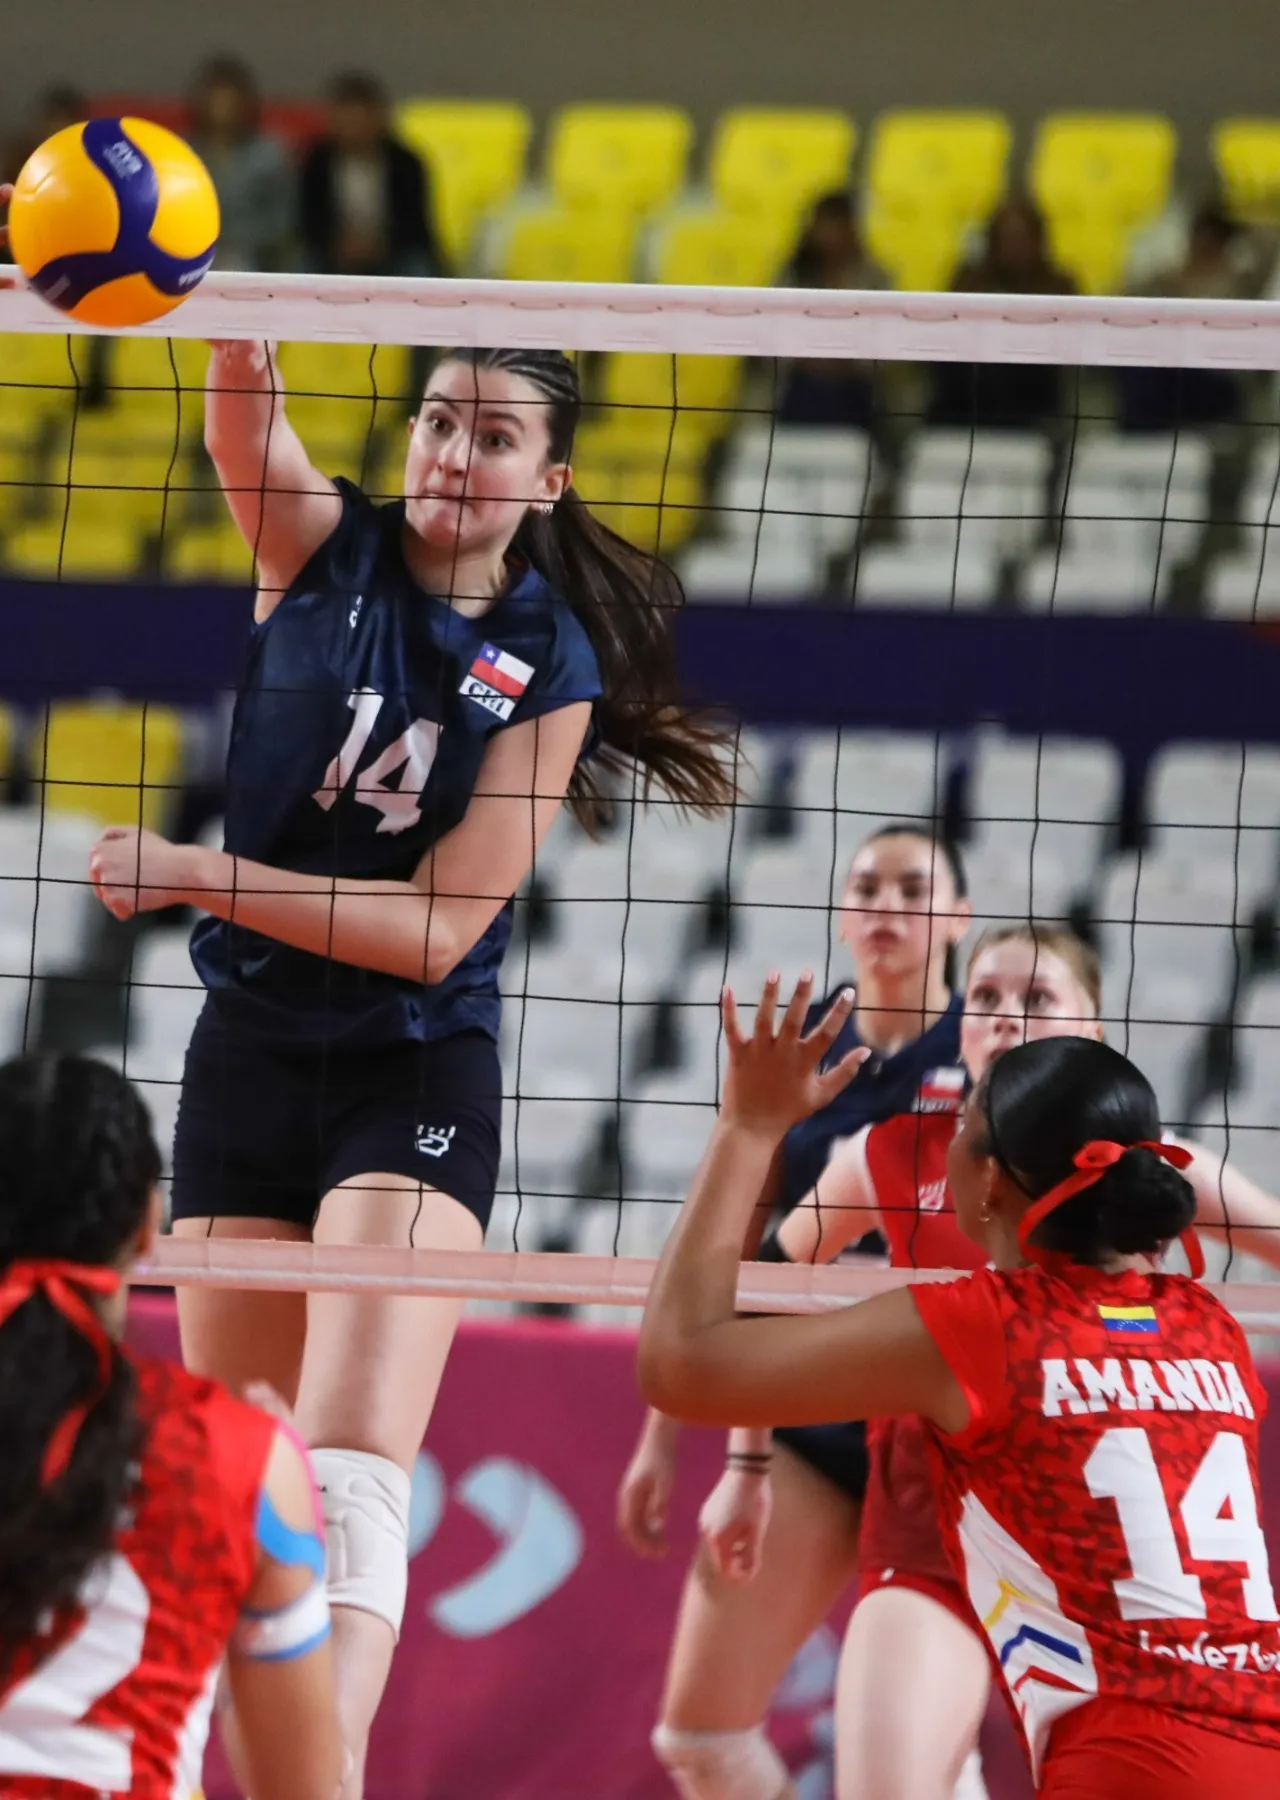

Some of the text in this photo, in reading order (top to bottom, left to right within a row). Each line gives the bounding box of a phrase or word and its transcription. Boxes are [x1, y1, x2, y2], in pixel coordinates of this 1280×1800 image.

[312, 687, 444, 835] 14
[1040, 1358, 1256, 1420] AMANDA
[1083, 1427, 1280, 1622] 14
